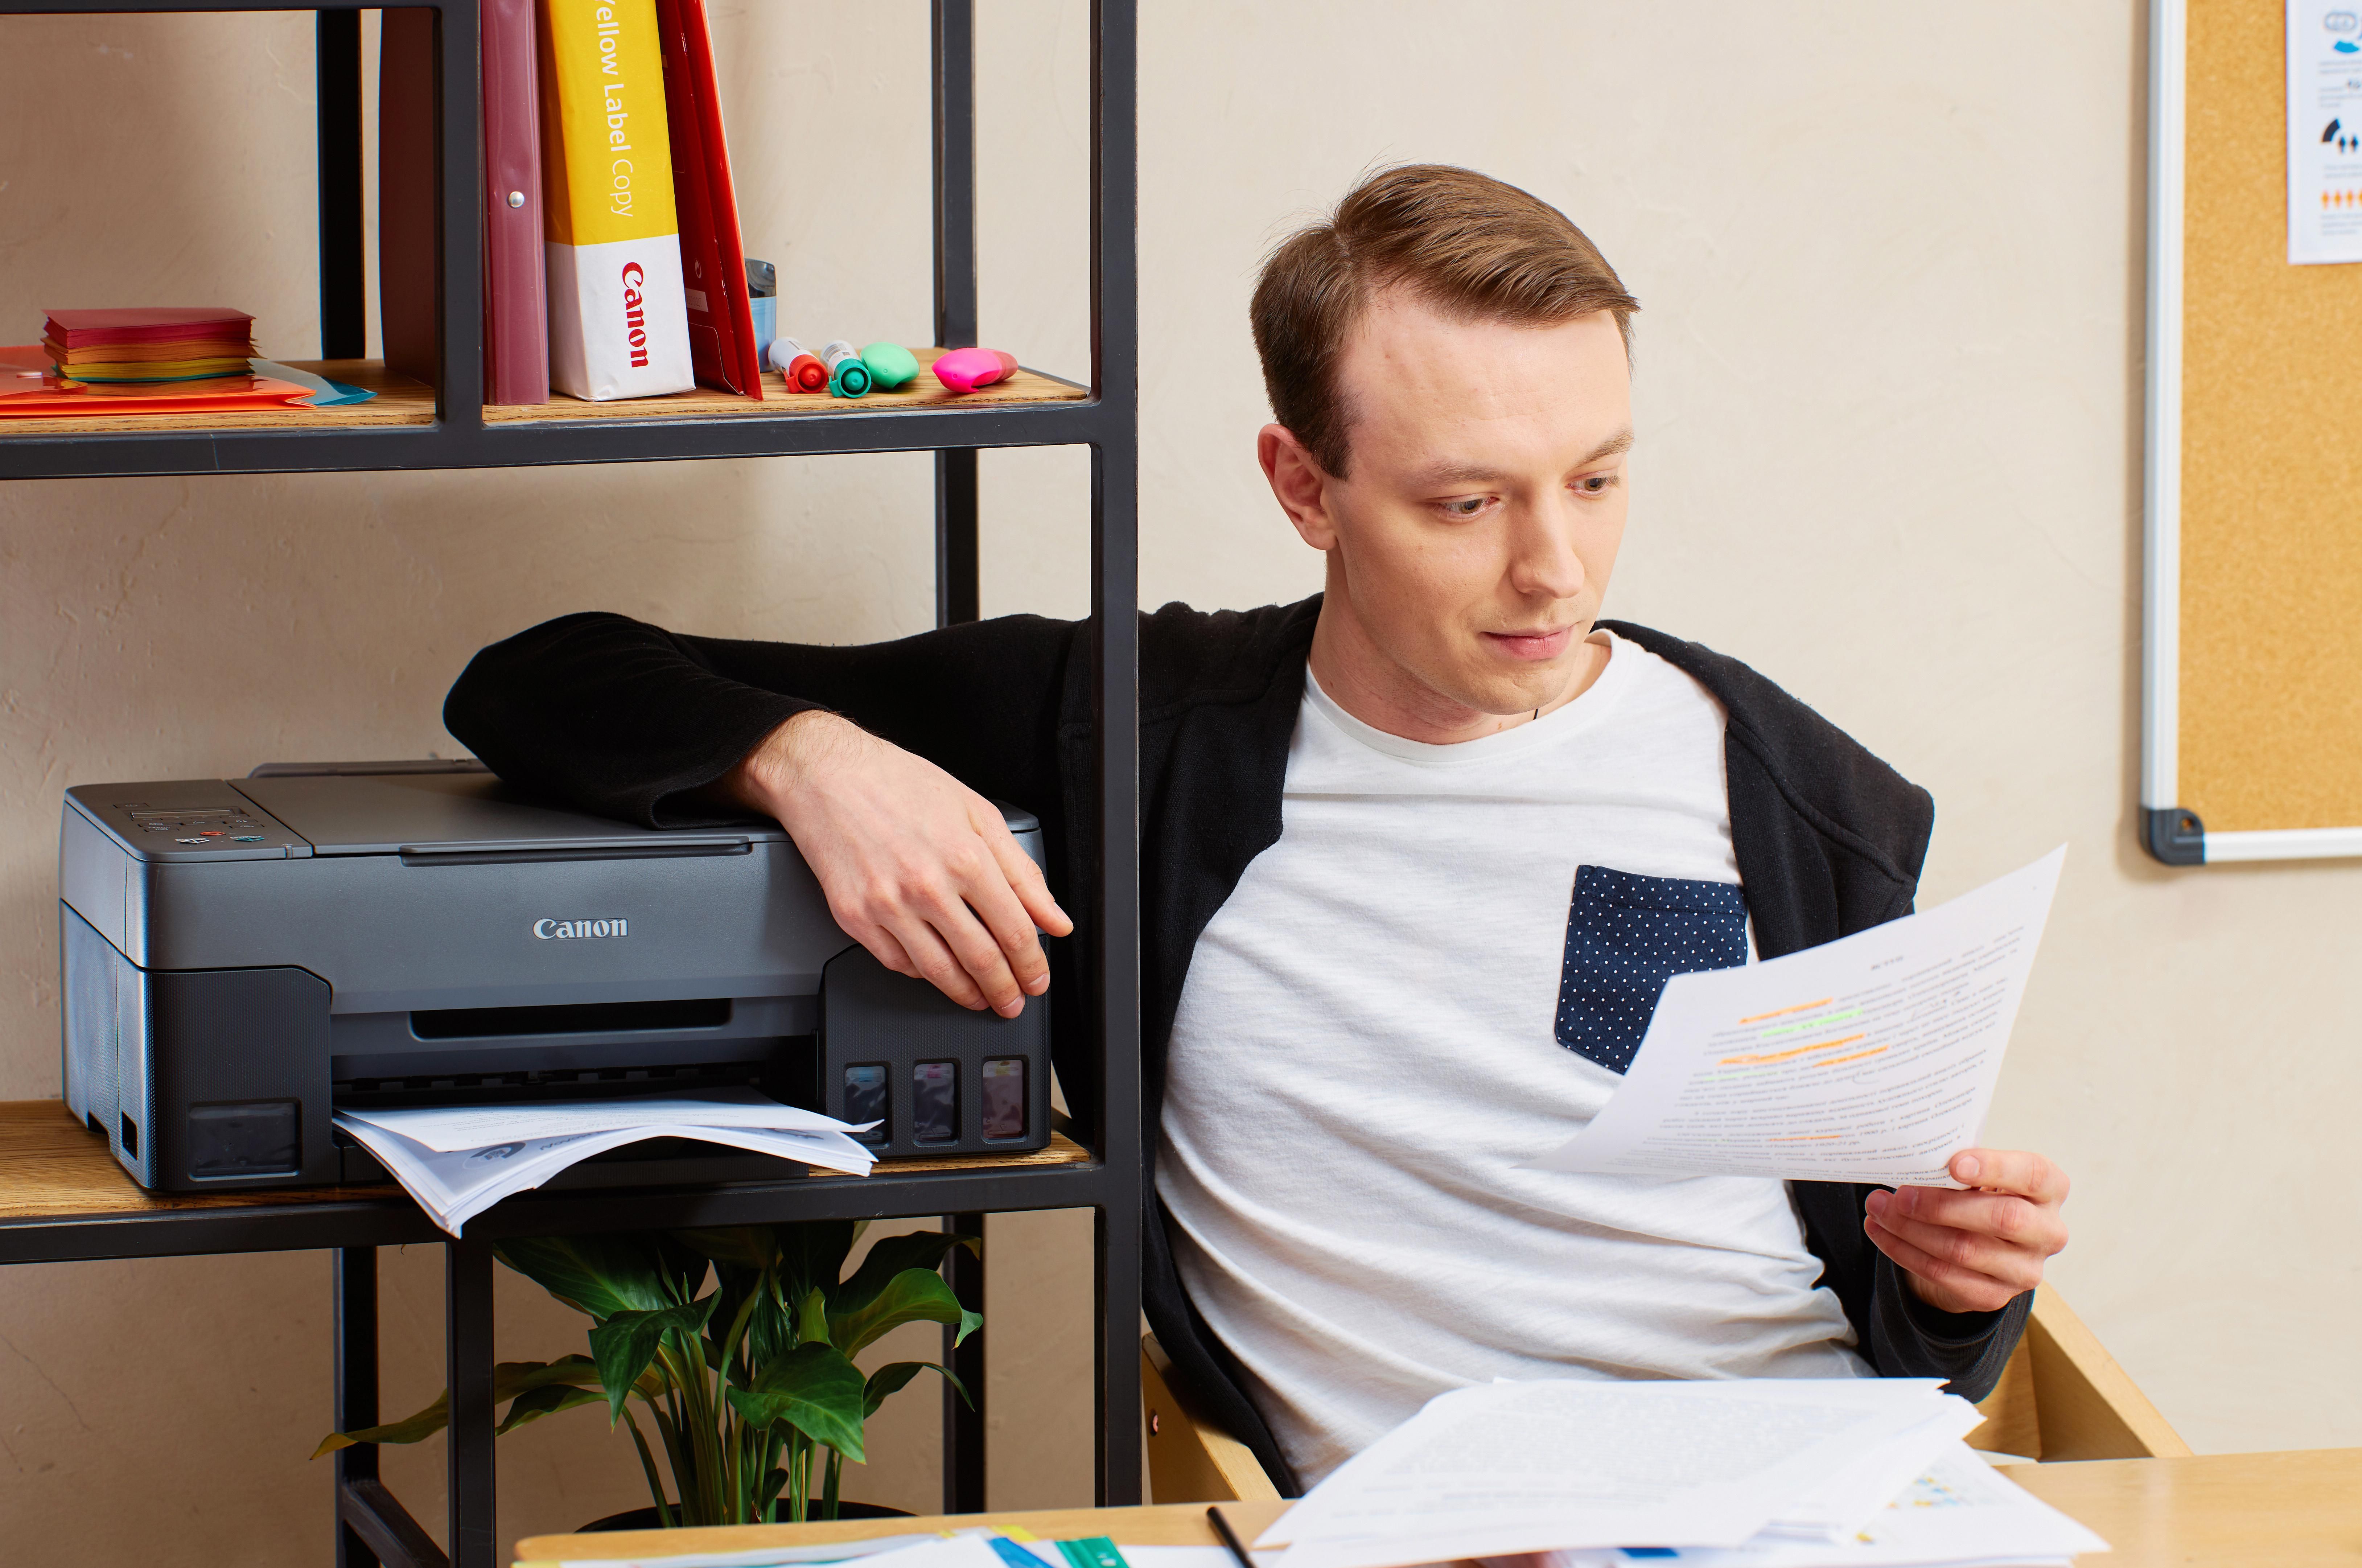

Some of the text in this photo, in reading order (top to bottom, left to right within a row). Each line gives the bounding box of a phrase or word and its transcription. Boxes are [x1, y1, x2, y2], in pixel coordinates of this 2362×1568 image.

[604, 83, 631, 151] Label
[610, 159, 633, 217] Copy
[622, 262, 649, 368] Canon
[533, 919, 627, 940] Canon
